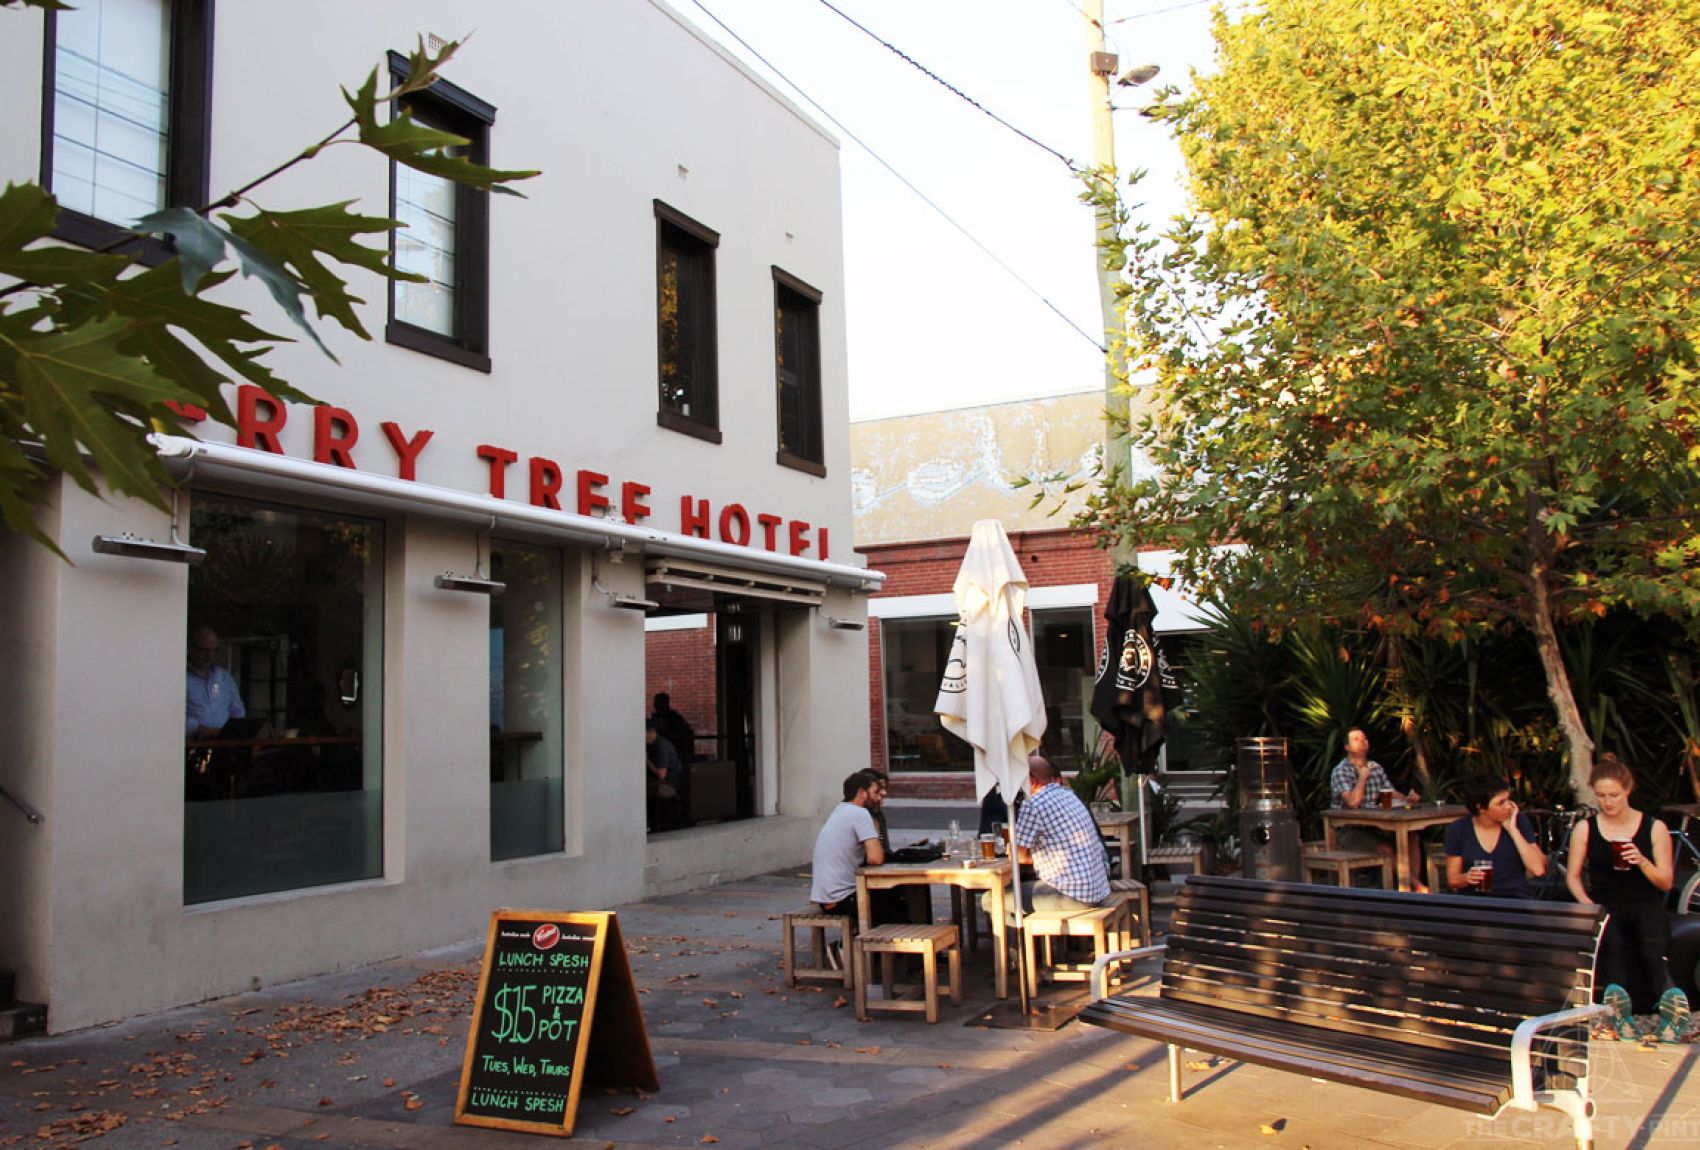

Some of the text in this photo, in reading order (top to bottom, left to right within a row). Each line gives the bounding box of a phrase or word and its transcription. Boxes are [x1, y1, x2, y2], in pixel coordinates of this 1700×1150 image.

[499, 951, 589, 968] LUNCH SPESH
[491, 982, 583, 1044] $15 PIZZA
[538, 1019, 578, 1041] POT
[471, 1092, 564, 1112] LUNCH SPESH
